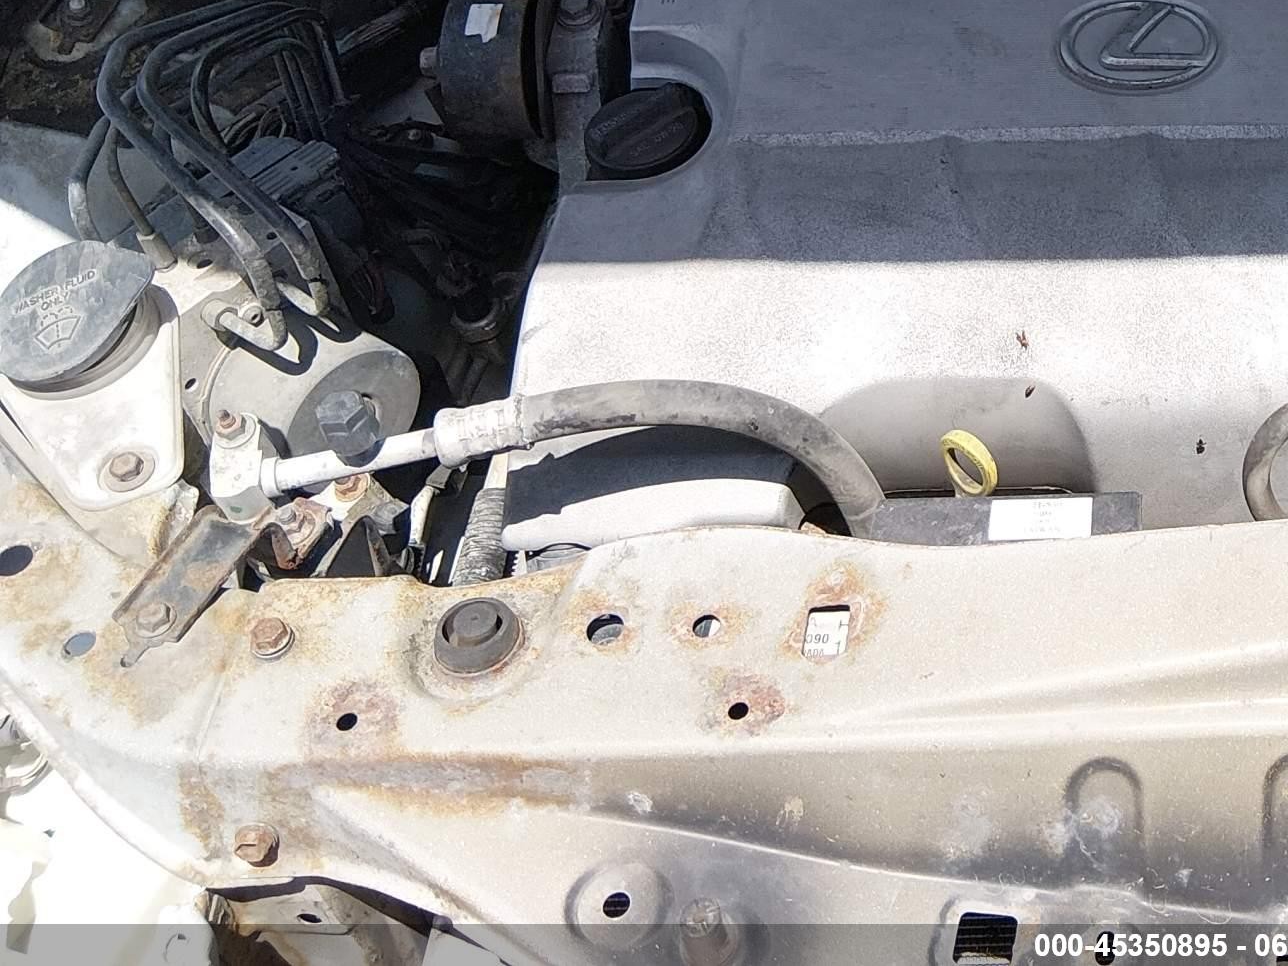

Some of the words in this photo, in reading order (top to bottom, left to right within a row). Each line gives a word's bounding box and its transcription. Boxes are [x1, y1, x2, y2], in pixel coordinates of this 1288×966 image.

[15, 286, 59, 314] WASHER
[65, 270, 95, 289] FLUID
[41, 292, 70, 311] ONLY
